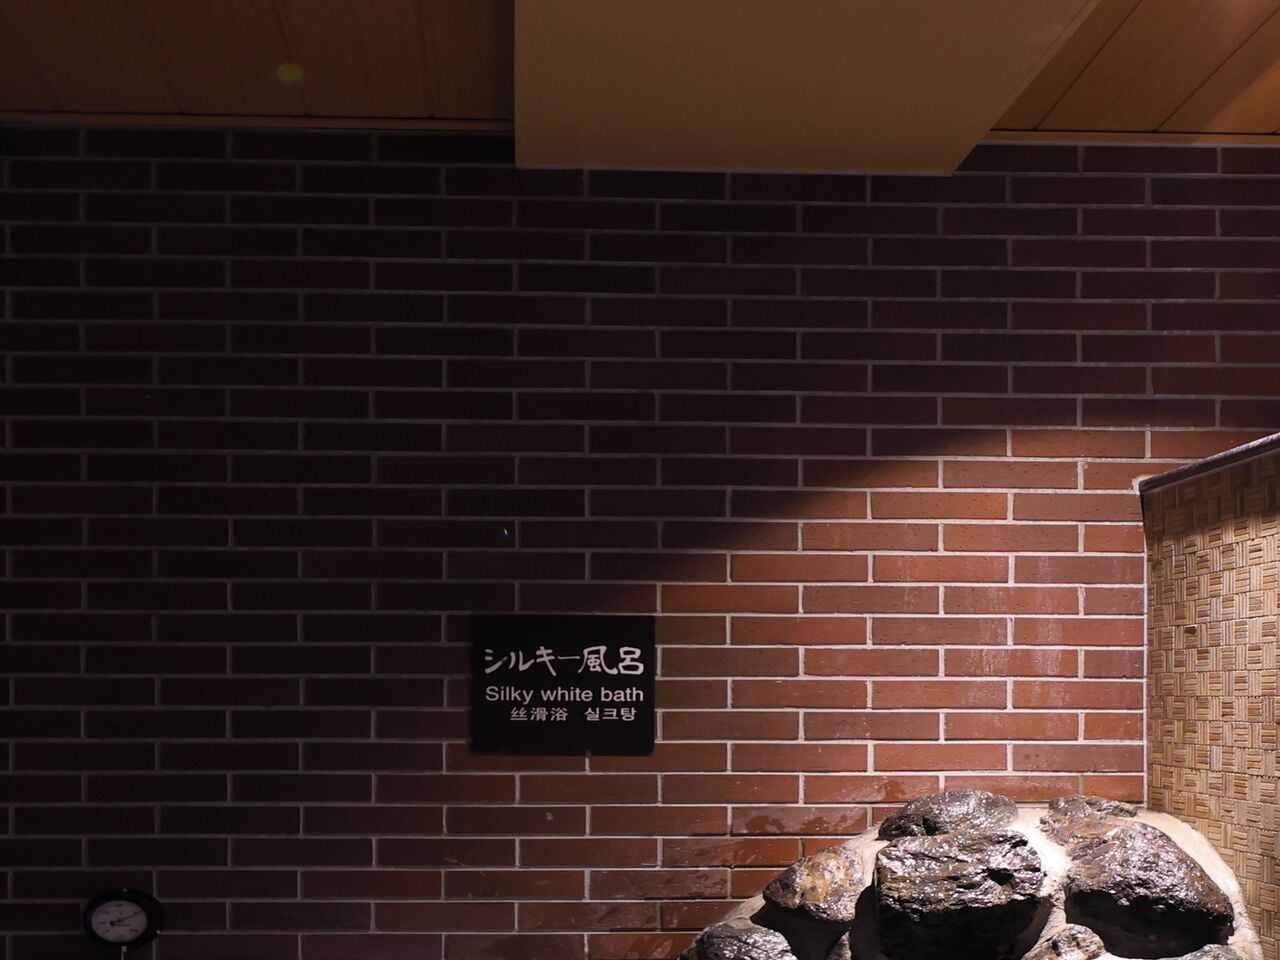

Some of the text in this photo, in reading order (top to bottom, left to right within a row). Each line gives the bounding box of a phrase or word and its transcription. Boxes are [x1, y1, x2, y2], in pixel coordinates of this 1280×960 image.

[484, 645, 645, 677] シルキー風呂
[485, 685, 644, 705] Silky white bath
[510, 707, 569, 722] 丝滑浴
[584, 706, 637, 722] 실크탕
